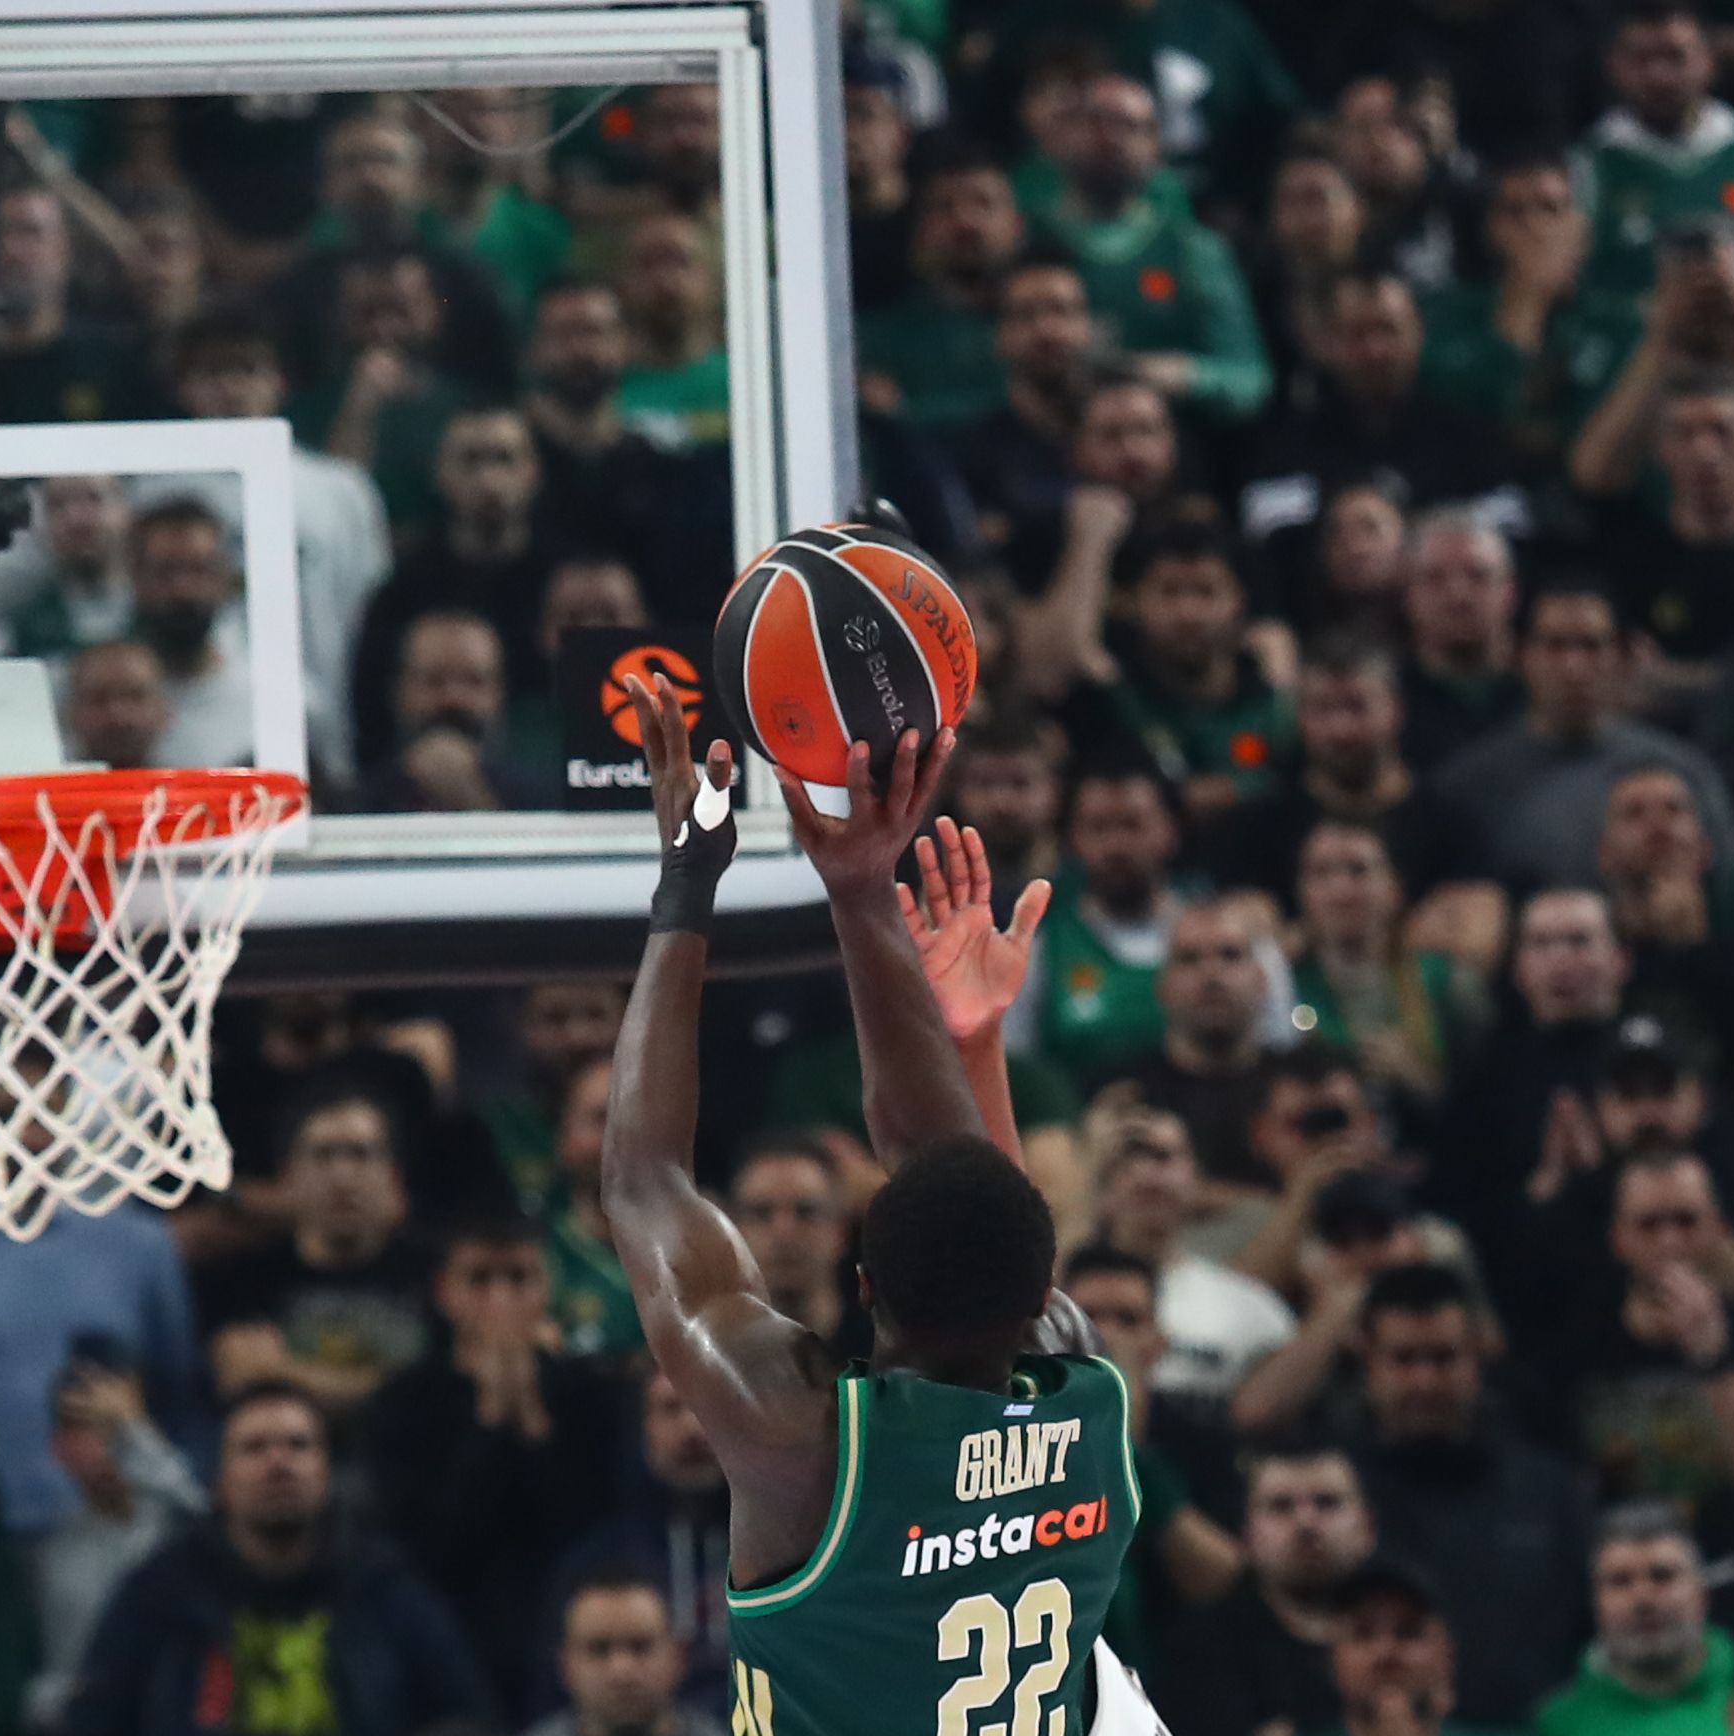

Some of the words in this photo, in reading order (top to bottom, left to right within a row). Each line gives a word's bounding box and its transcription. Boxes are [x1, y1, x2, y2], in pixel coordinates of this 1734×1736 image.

[892, 569, 970, 716] SPALDIN
[867, 651, 908, 738] EuroLe
[568, 758, 741, 788] EuroL
[955, 1417, 1081, 1502] GRANT
